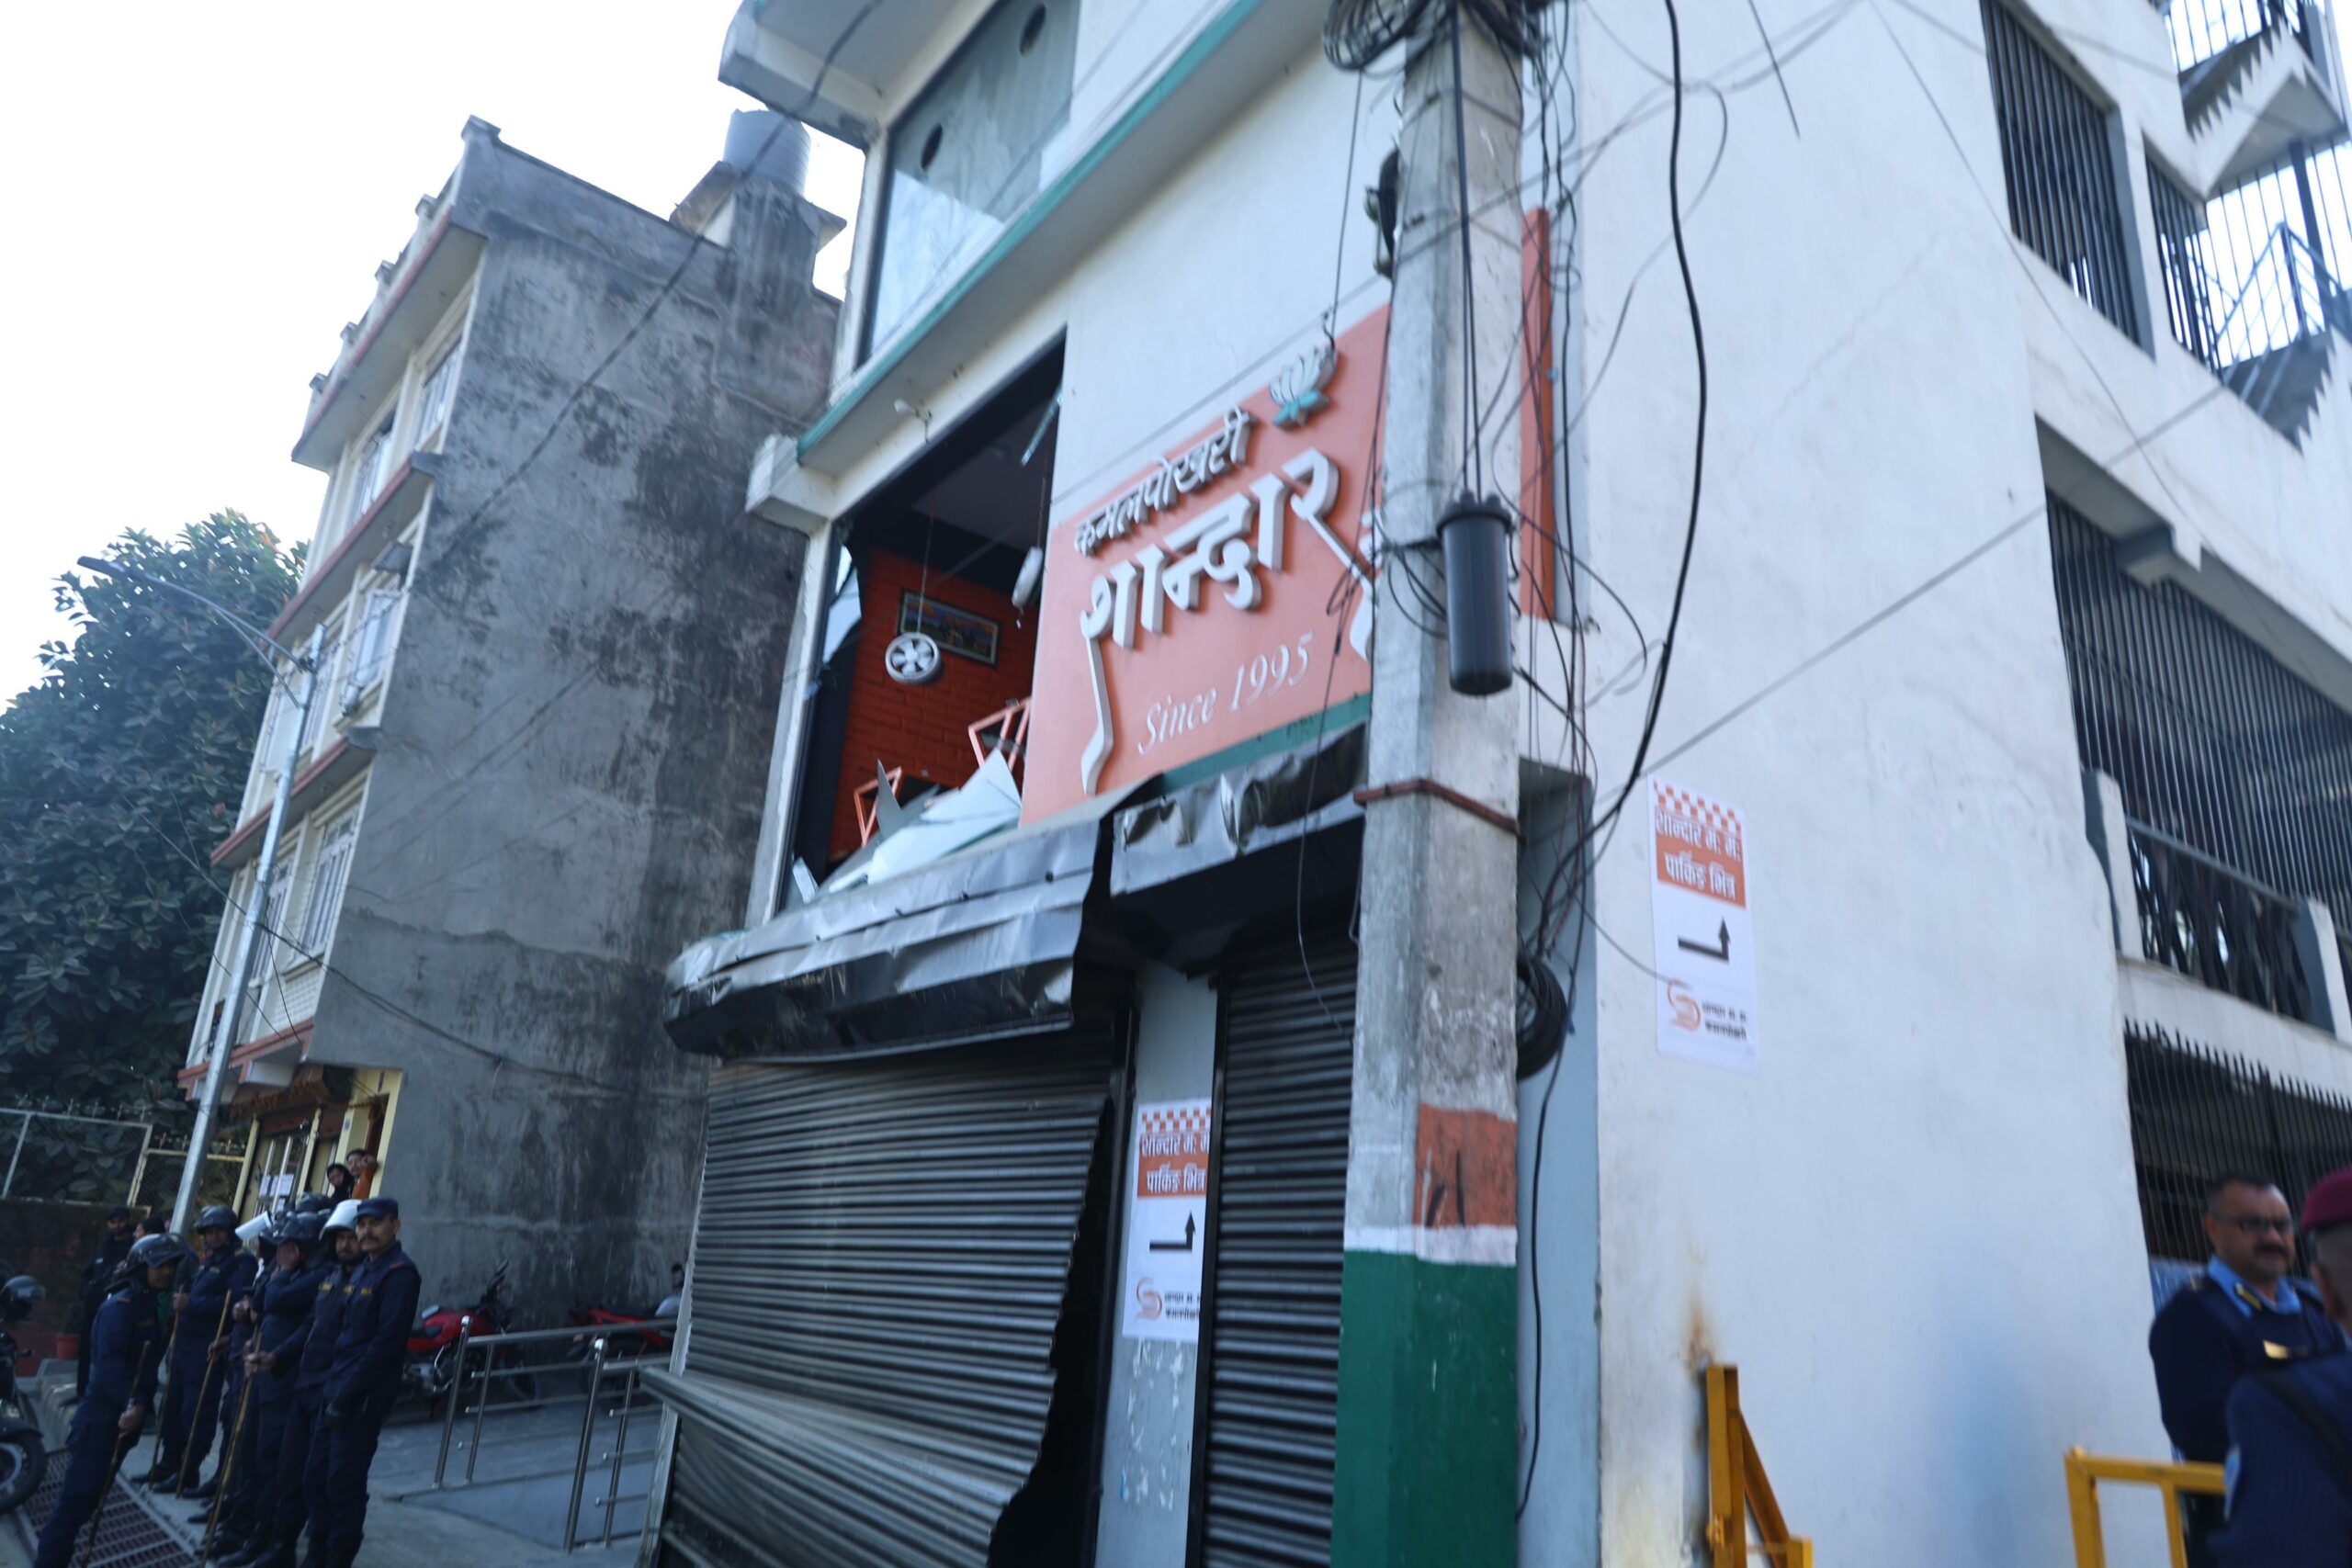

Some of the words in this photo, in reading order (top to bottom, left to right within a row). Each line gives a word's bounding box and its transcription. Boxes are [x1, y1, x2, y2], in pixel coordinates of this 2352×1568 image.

[1073, 404, 1251, 557] कमलपोखरी
[1080, 446, 1374, 795] शान्दार
[1137, 687, 1218, 755] Since
[1229, 630, 1314, 713] 1995
